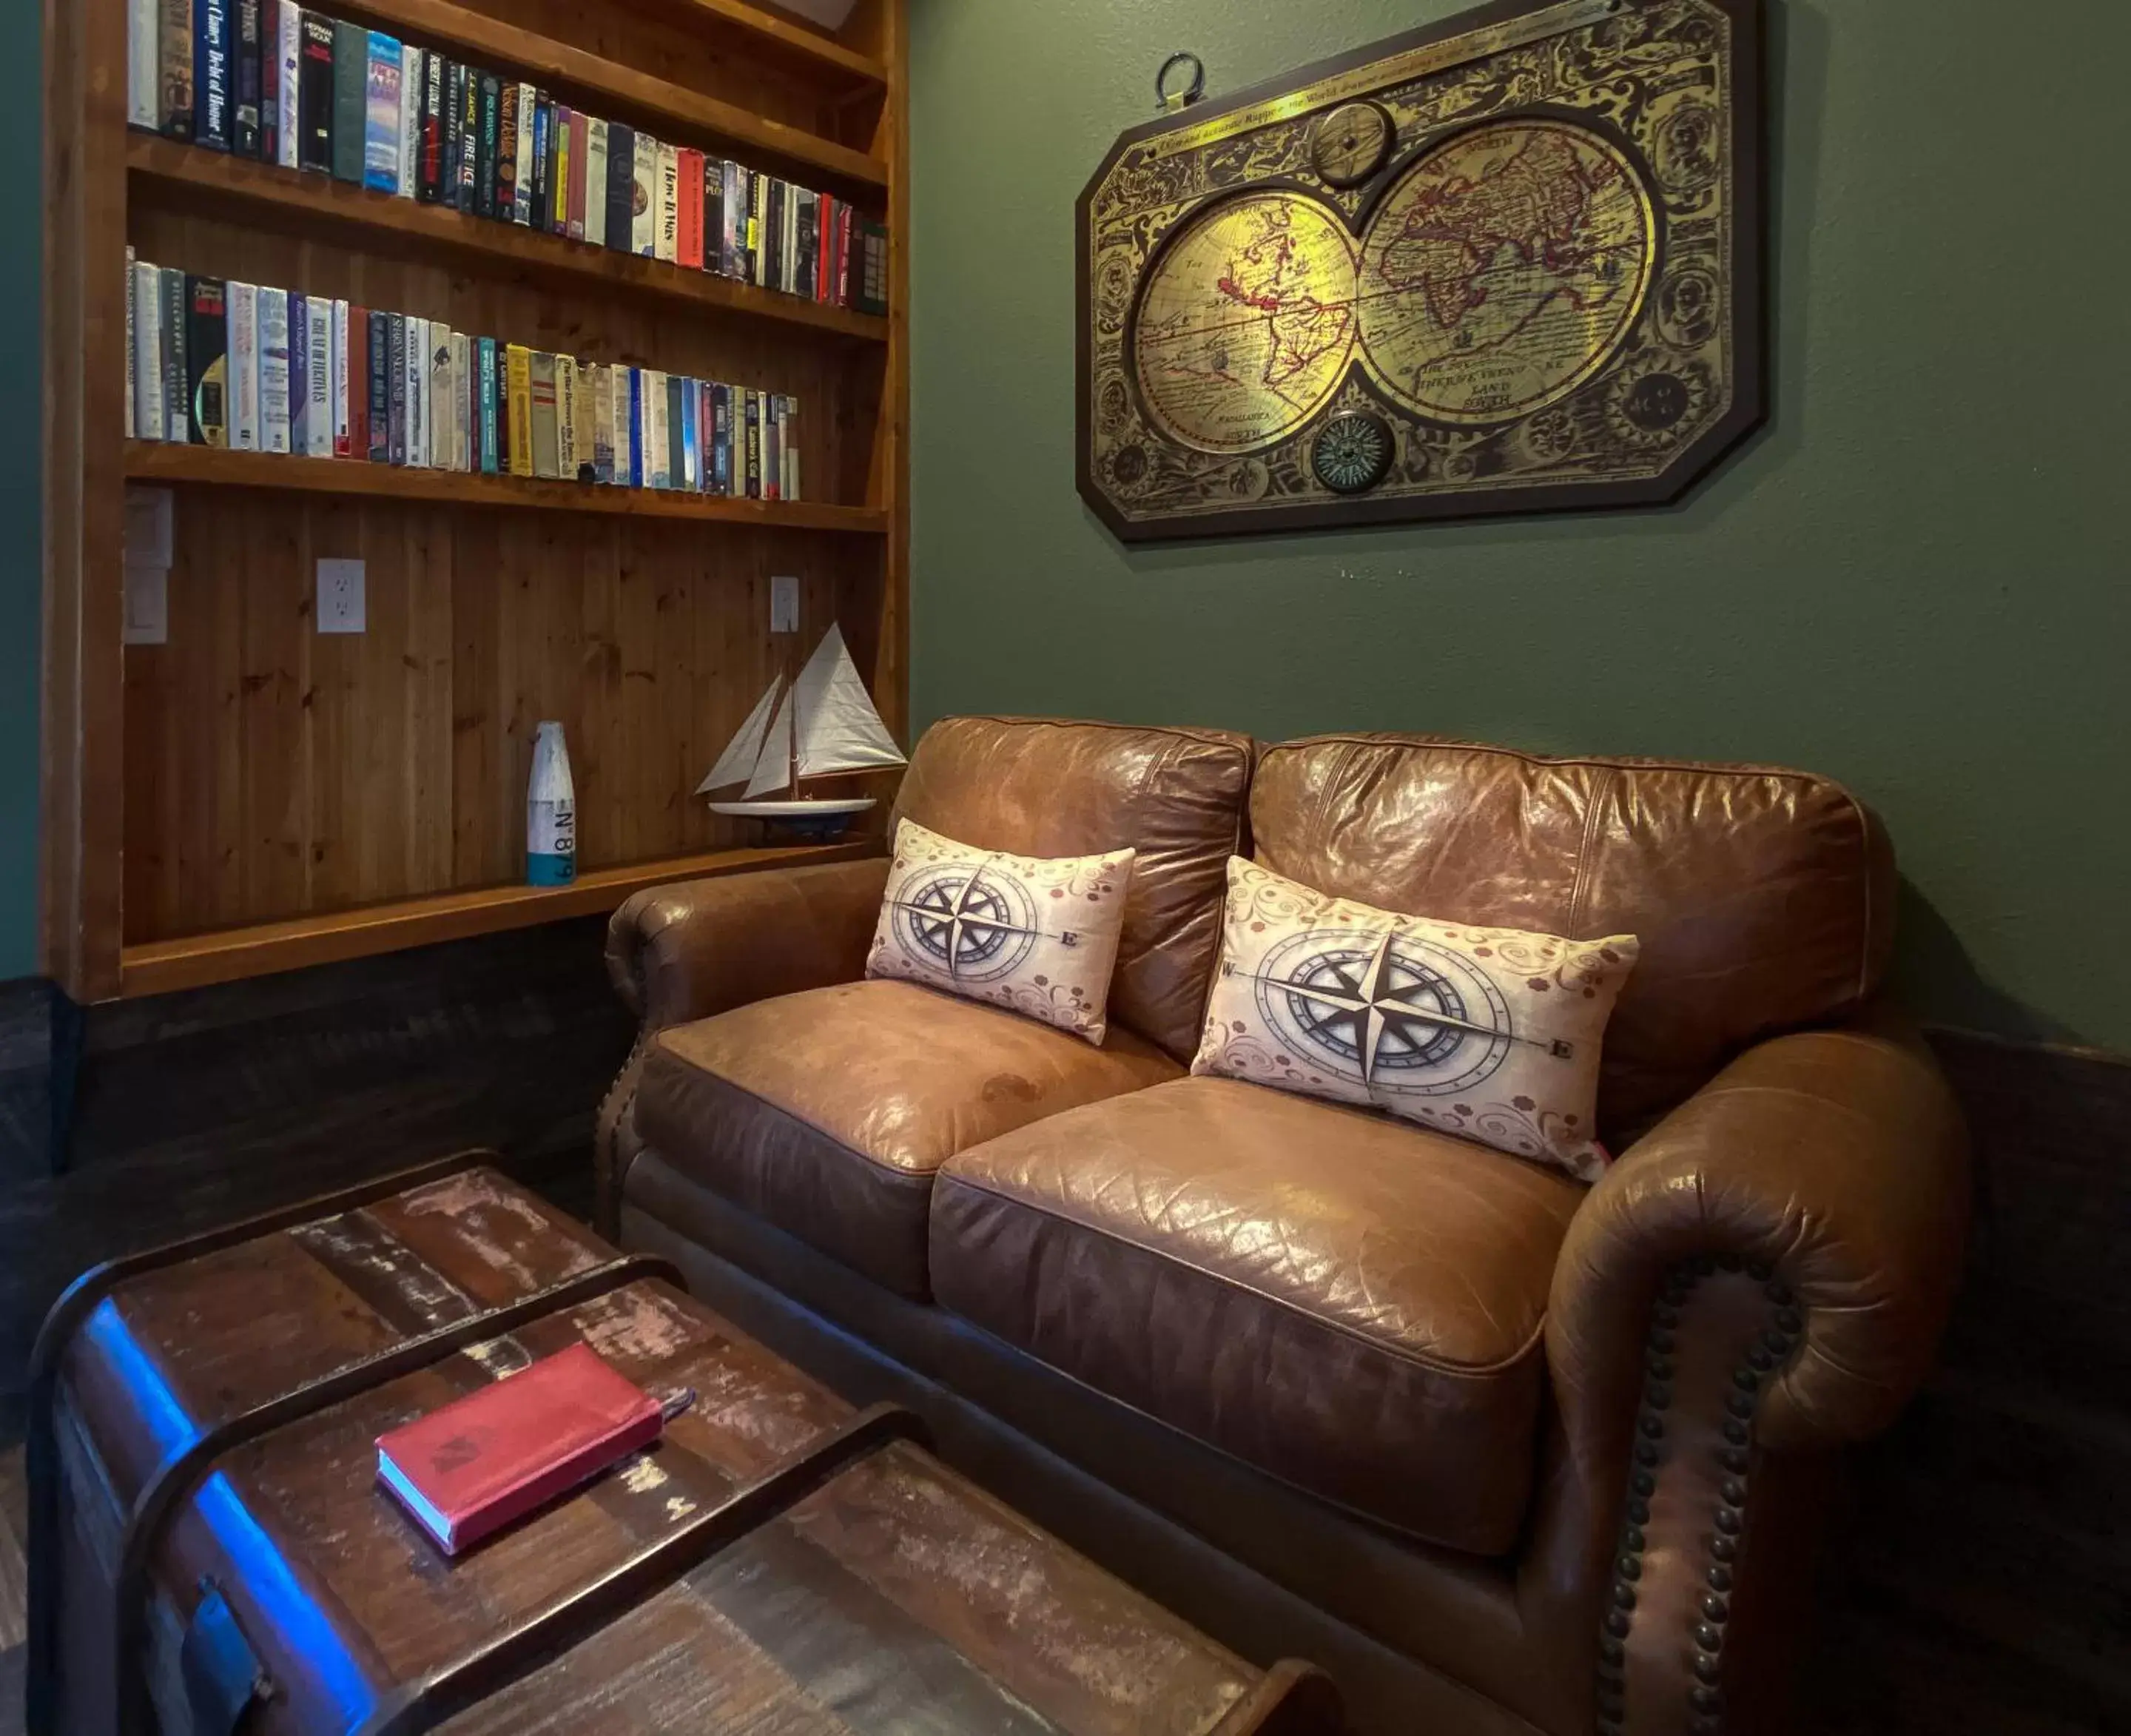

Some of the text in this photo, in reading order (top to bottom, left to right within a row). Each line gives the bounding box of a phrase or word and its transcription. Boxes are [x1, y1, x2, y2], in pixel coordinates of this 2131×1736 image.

[205, 7, 225, 132] Clancy Debt of Honor
[467, 91, 477, 125] JANCE
[463, 134, 477, 186] FIRE ICE
[664, 165, 676, 198] How
[664, 214, 676, 242] Was
[1061, 931, 1078, 947] E
[1549, 1037, 1575, 1060] E
